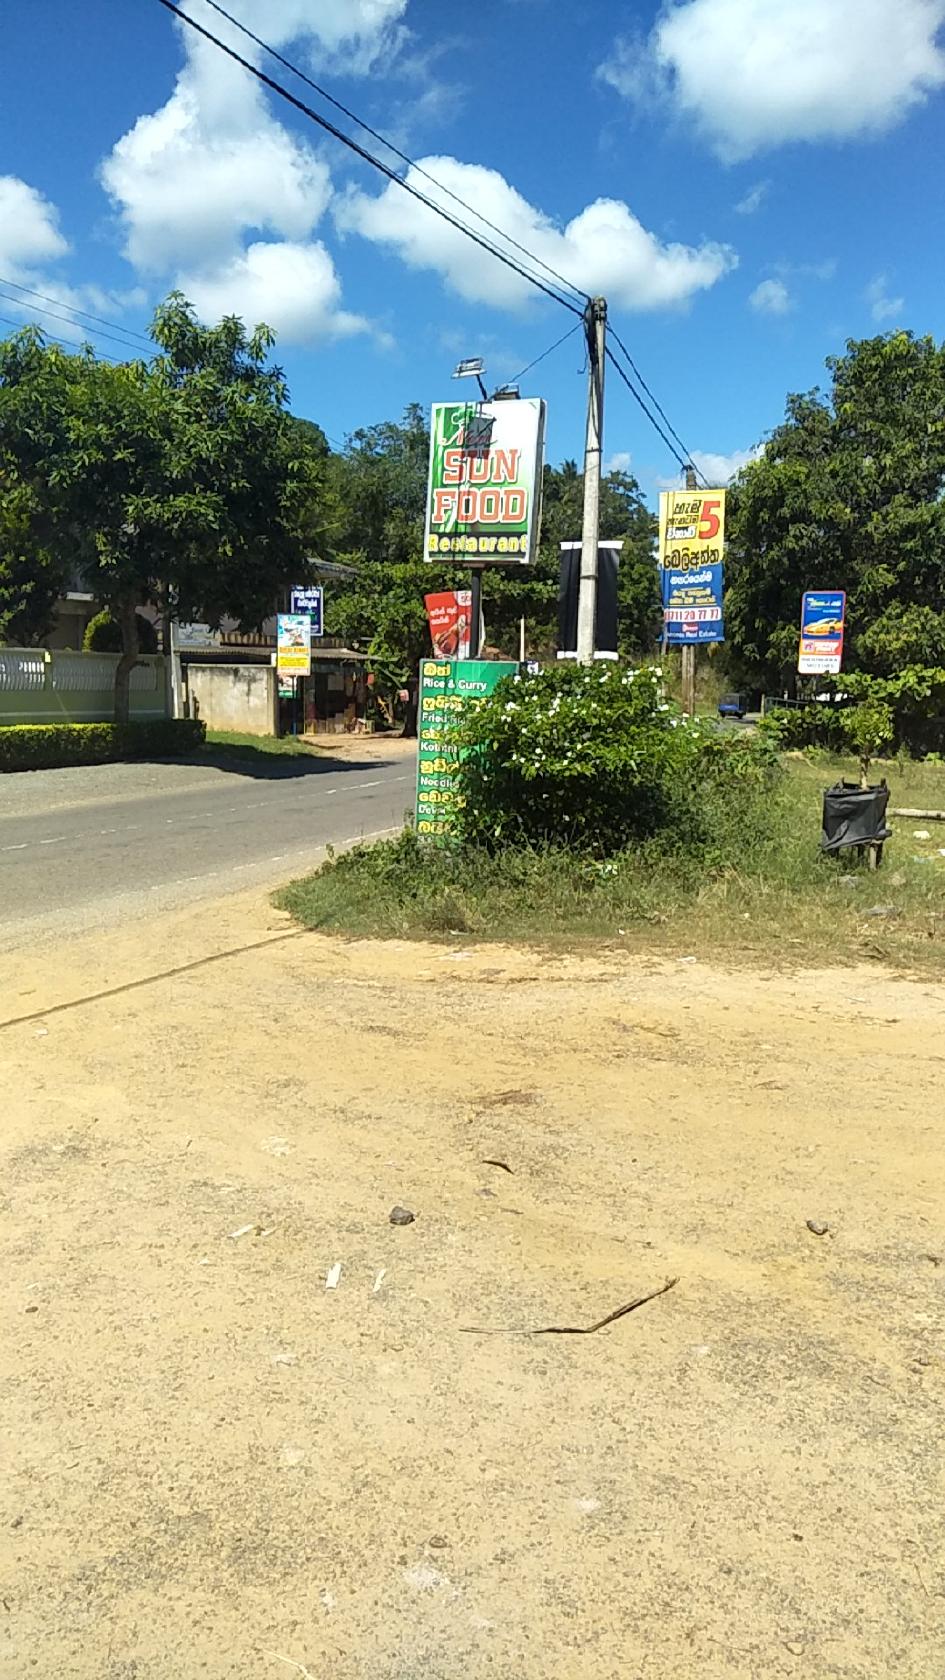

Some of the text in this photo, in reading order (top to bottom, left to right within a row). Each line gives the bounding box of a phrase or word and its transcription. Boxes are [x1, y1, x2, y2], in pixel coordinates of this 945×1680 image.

[443, 448, 520, 485] SUN
[432, 488, 527, 524] FOOD
[699, 501, 720, 539] 5
[428, 534, 528, 553] Restaurant
[423, 677, 487, 692] Rice & Curry
